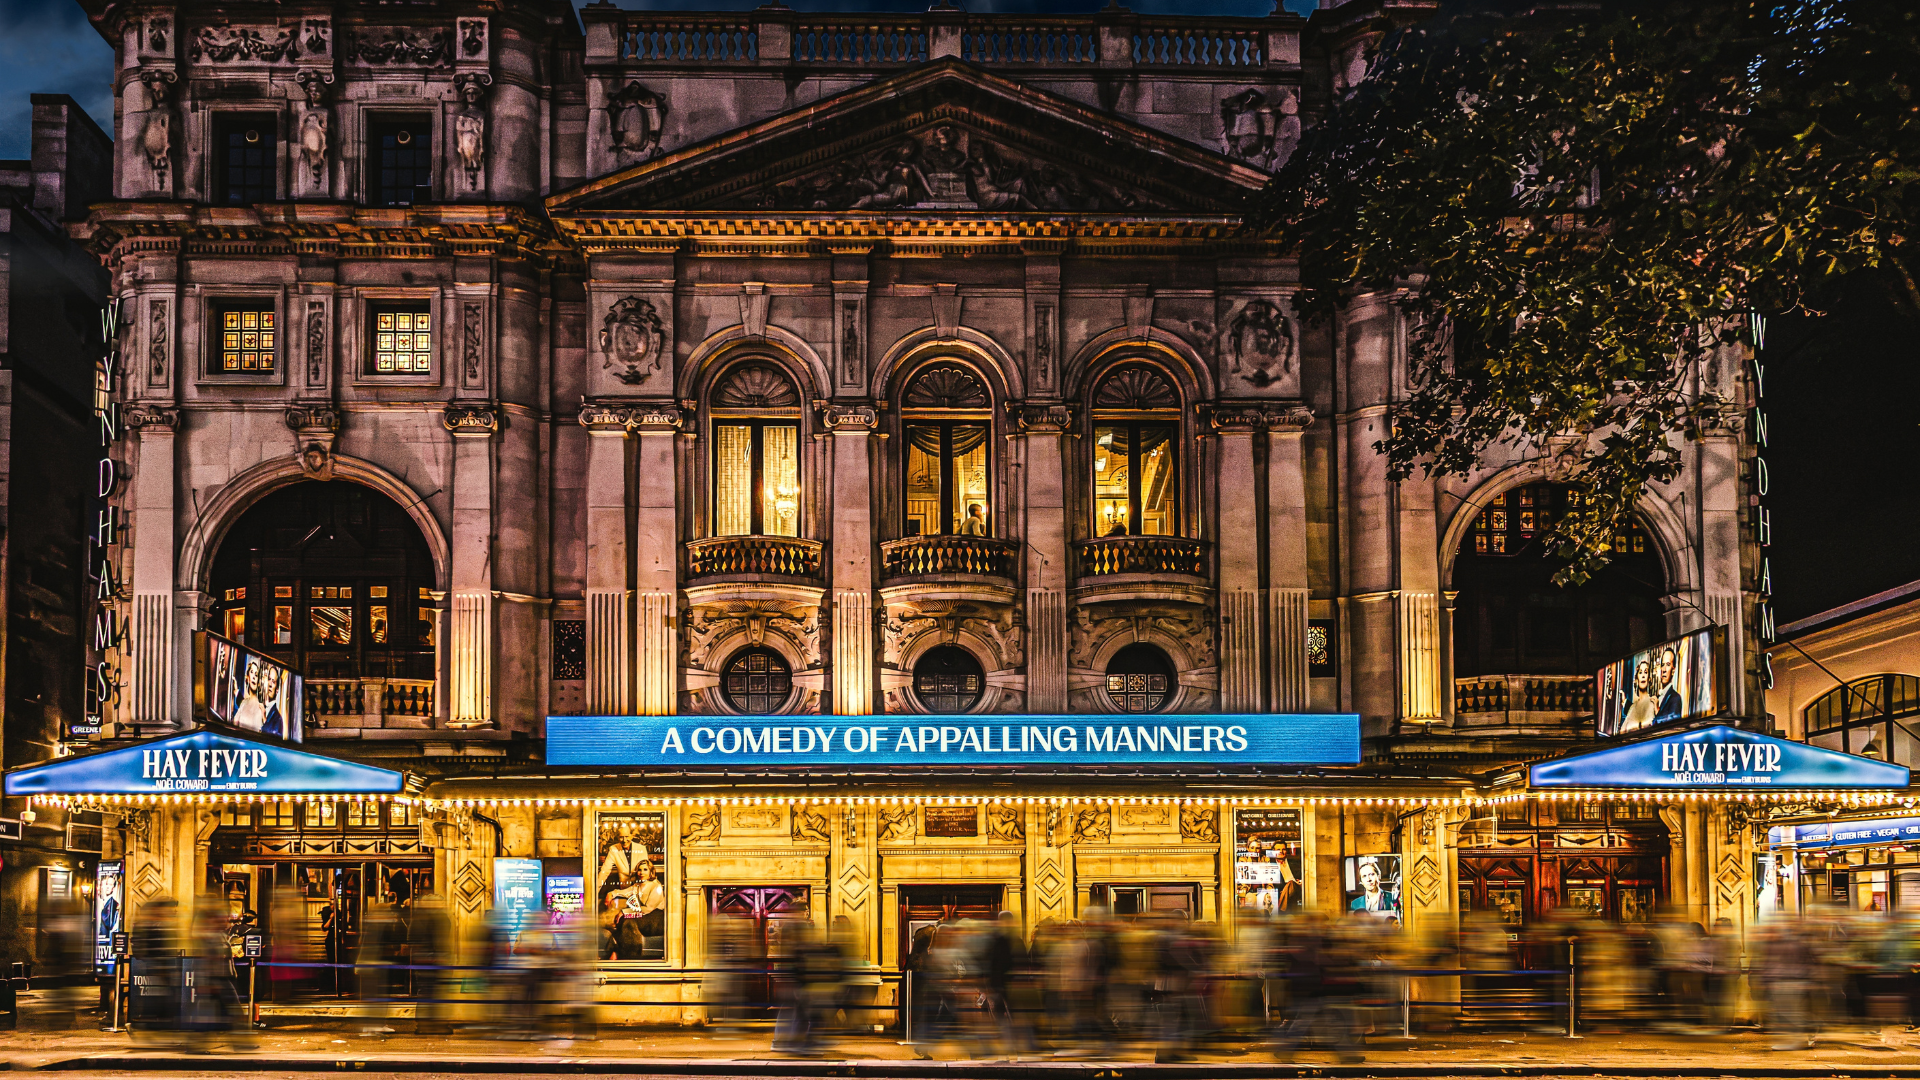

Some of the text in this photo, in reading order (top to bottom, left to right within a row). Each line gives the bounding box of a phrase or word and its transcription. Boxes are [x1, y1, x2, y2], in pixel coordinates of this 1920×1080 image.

[95, 298, 119, 702] WYNDHAMS
[1750, 306, 1776, 690] WYNDHAMS
[660, 725, 1248, 753] A COMEDY OF APPALLING MANNERS
[142, 749, 268, 778] HAY FEVER
[1661, 743, 1781, 772] HAY FEVER
[155, 778, 175, 790] NOËL
[175, 779, 209, 790] COWARD
[1674, 771, 1693, 783] NOËL
[1693, 772, 1725, 783] COWARD
[1835, 831, 1857, 841] GLUTEN
[1857, 830, 1872, 839] FREE
[1876, 828, 1899, 837] VEGAN
